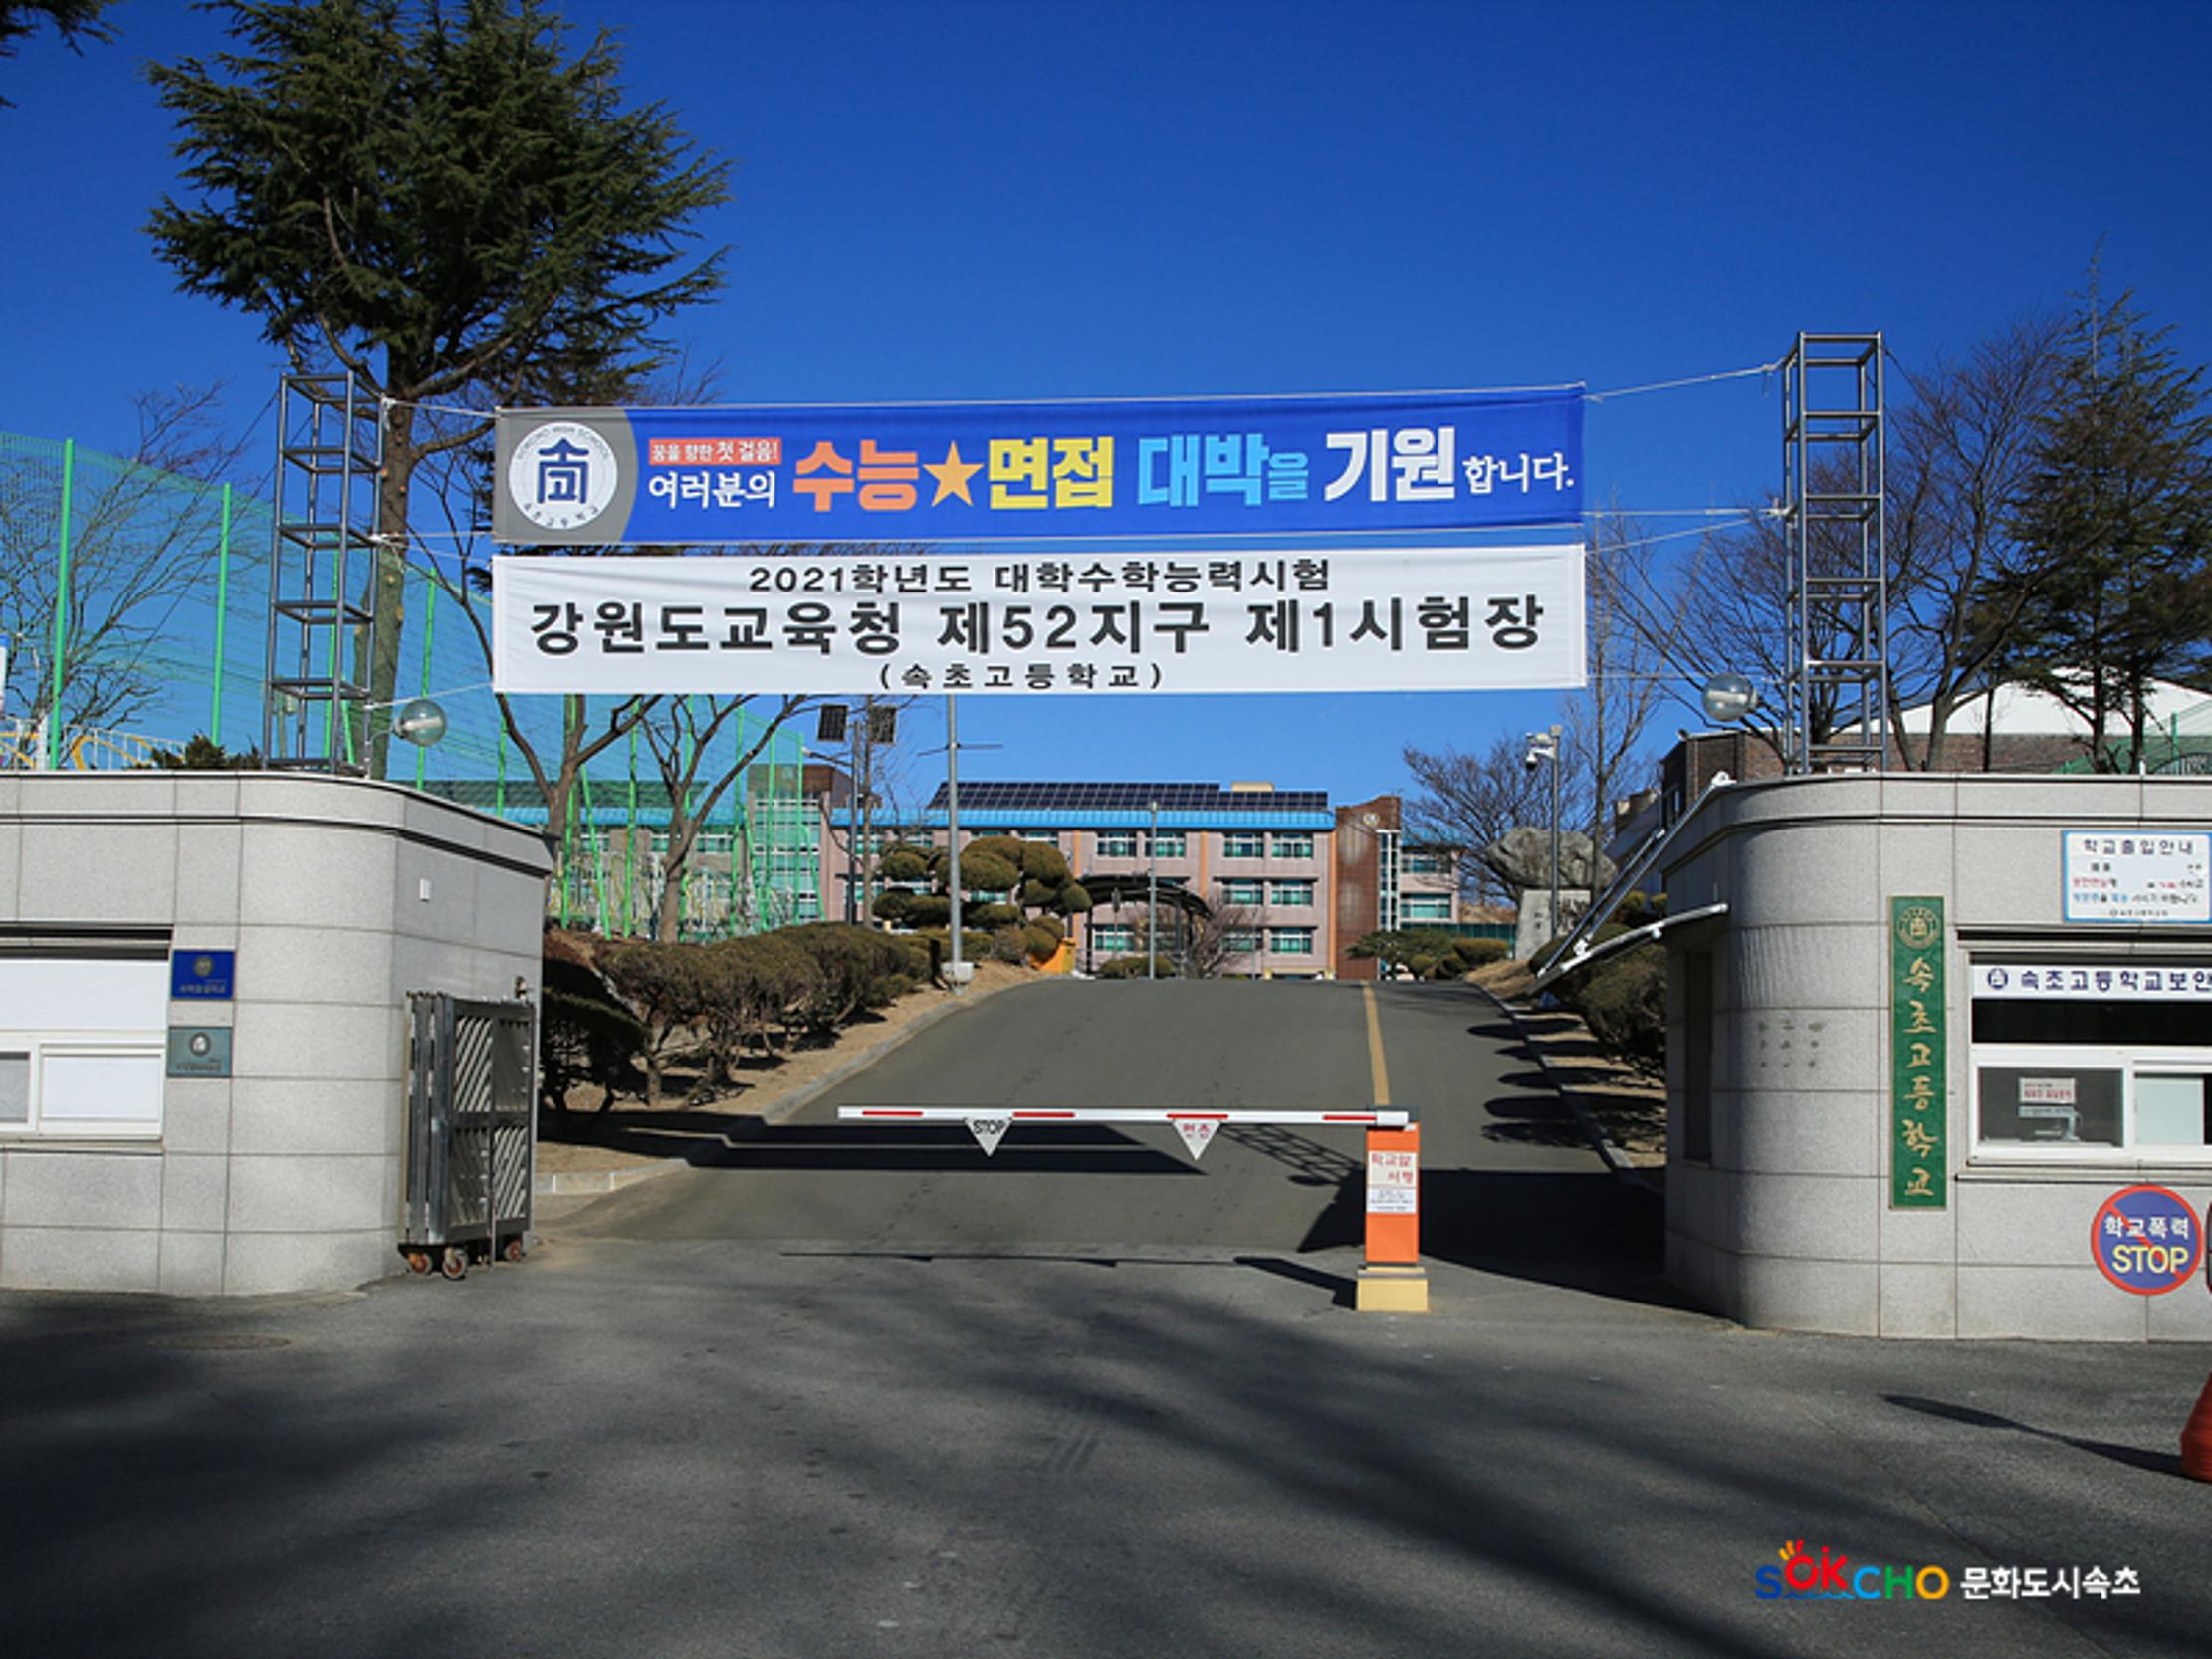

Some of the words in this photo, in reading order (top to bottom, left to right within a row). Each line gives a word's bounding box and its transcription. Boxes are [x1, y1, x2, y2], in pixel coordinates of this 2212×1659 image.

[653, 444, 681, 462] 꿈을
[684, 444, 713, 462] 향한
[716, 441, 735, 463] 첫
[738, 439, 778, 463] 걸음!
[649, 470, 775, 510] 여러분의
[793, 439, 920, 512] 수능
[990, 437, 1114, 510] 면접
[1138, 433, 1309, 507] 대박을
[750, 564, 972, 594] 2021학년도
[995, 559, 1330, 593] 대학수학능력시험
[531, 600, 901, 655] 강원도교육청
[937, 600, 1210, 654] 제52지구
[1245, 594, 1544, 653] 제1시험장
[880, 663, 1162, 690] (속초고등학교)
[1902, 957, 1938, 1196] 속초고등학교
[973, 1119, 1005, 1135] STOP
[2104, 1215, 2189, 1241] 학교폭력
[2111, 1244, 2190, 1274] STOP
